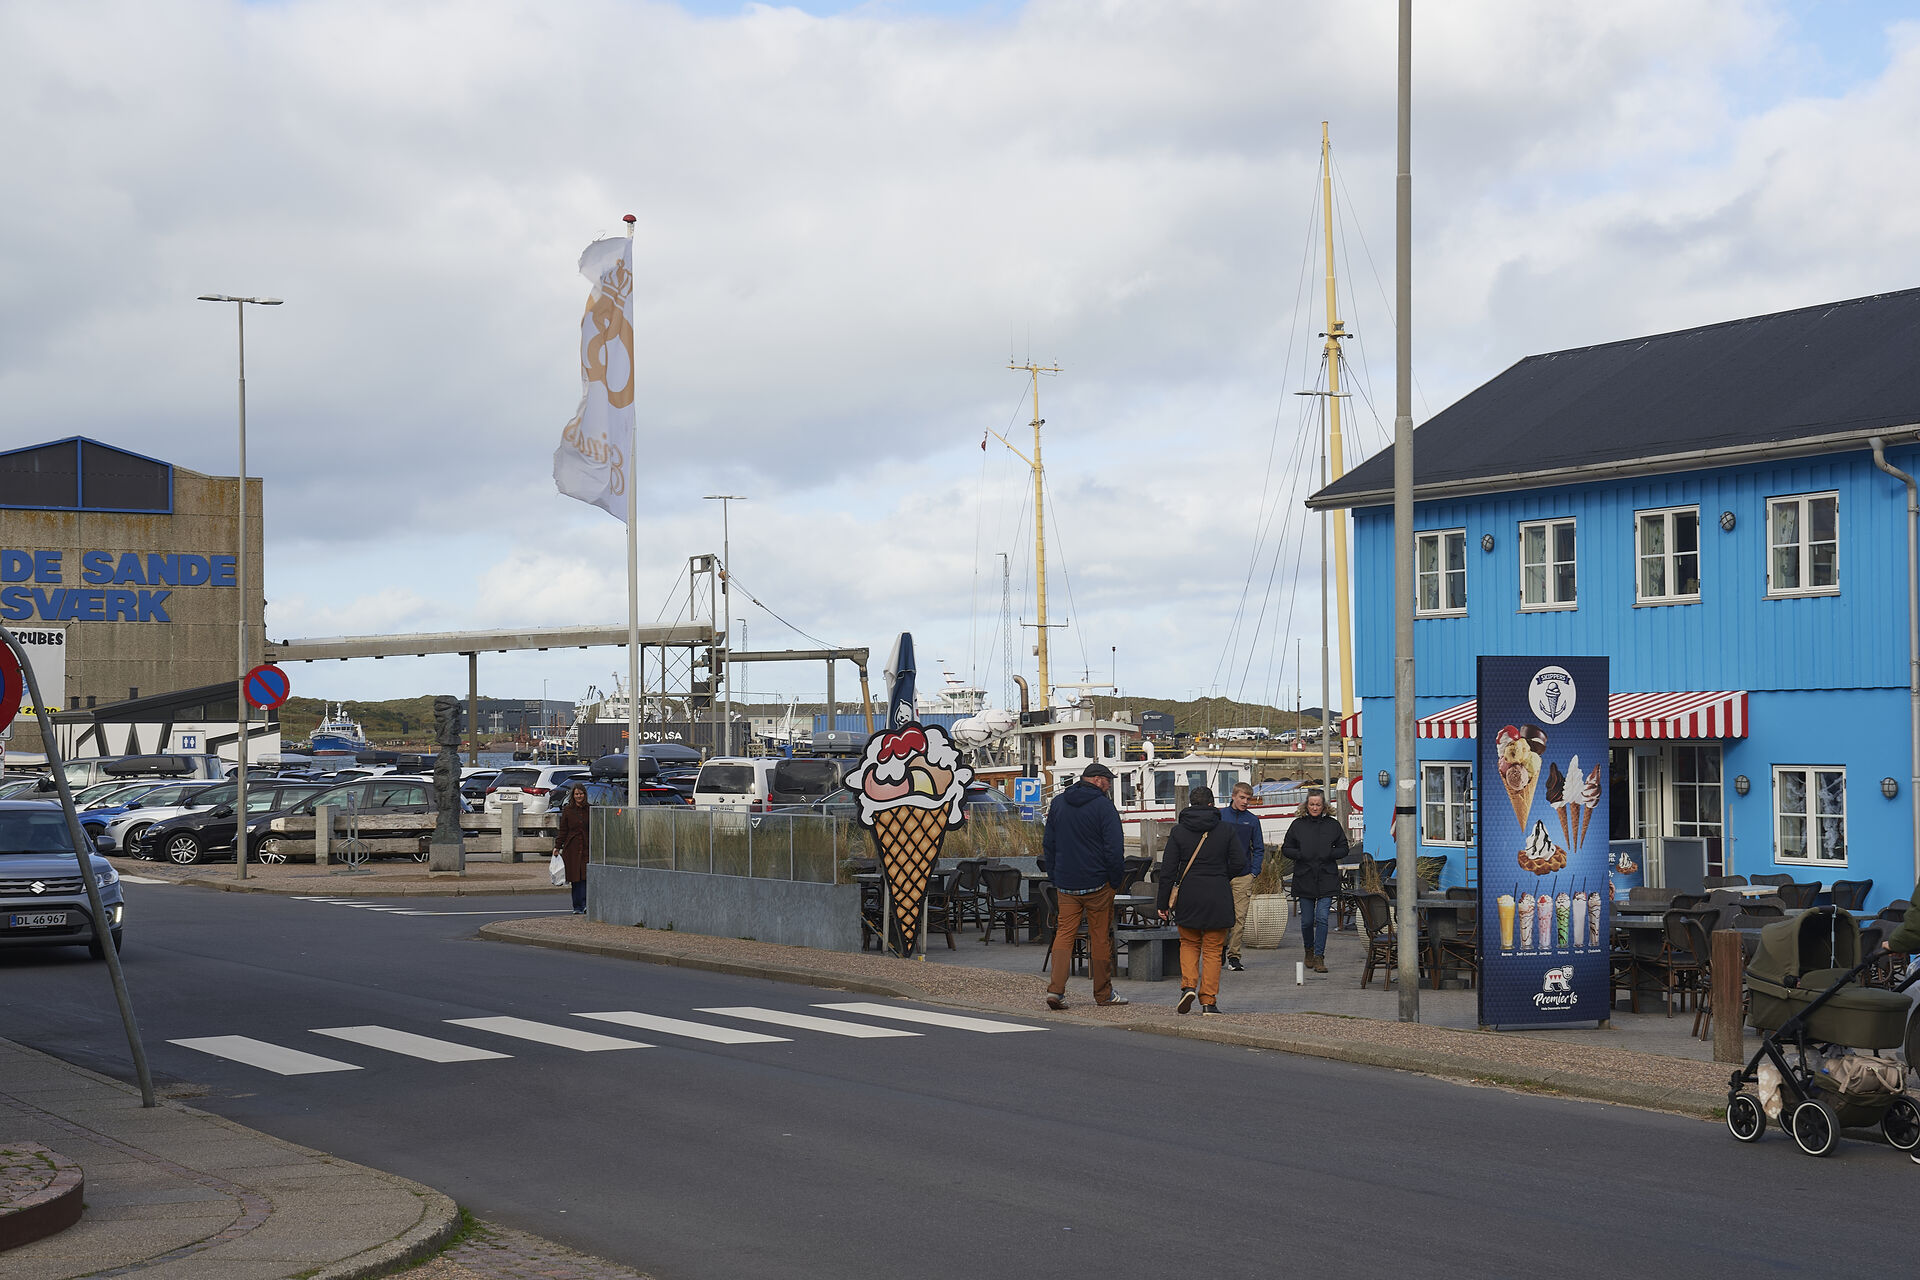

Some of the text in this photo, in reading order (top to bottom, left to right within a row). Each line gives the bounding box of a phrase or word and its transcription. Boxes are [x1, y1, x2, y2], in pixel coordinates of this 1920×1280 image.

[1, 549, 237, 587] DE SANDE
[0, 585, 173, 622] SVÆRK
[1021, 781, 1036, 802] P
[17, 914, 65, 925] DL 46 967
[1532, 992, 1570, 1006] Premier
